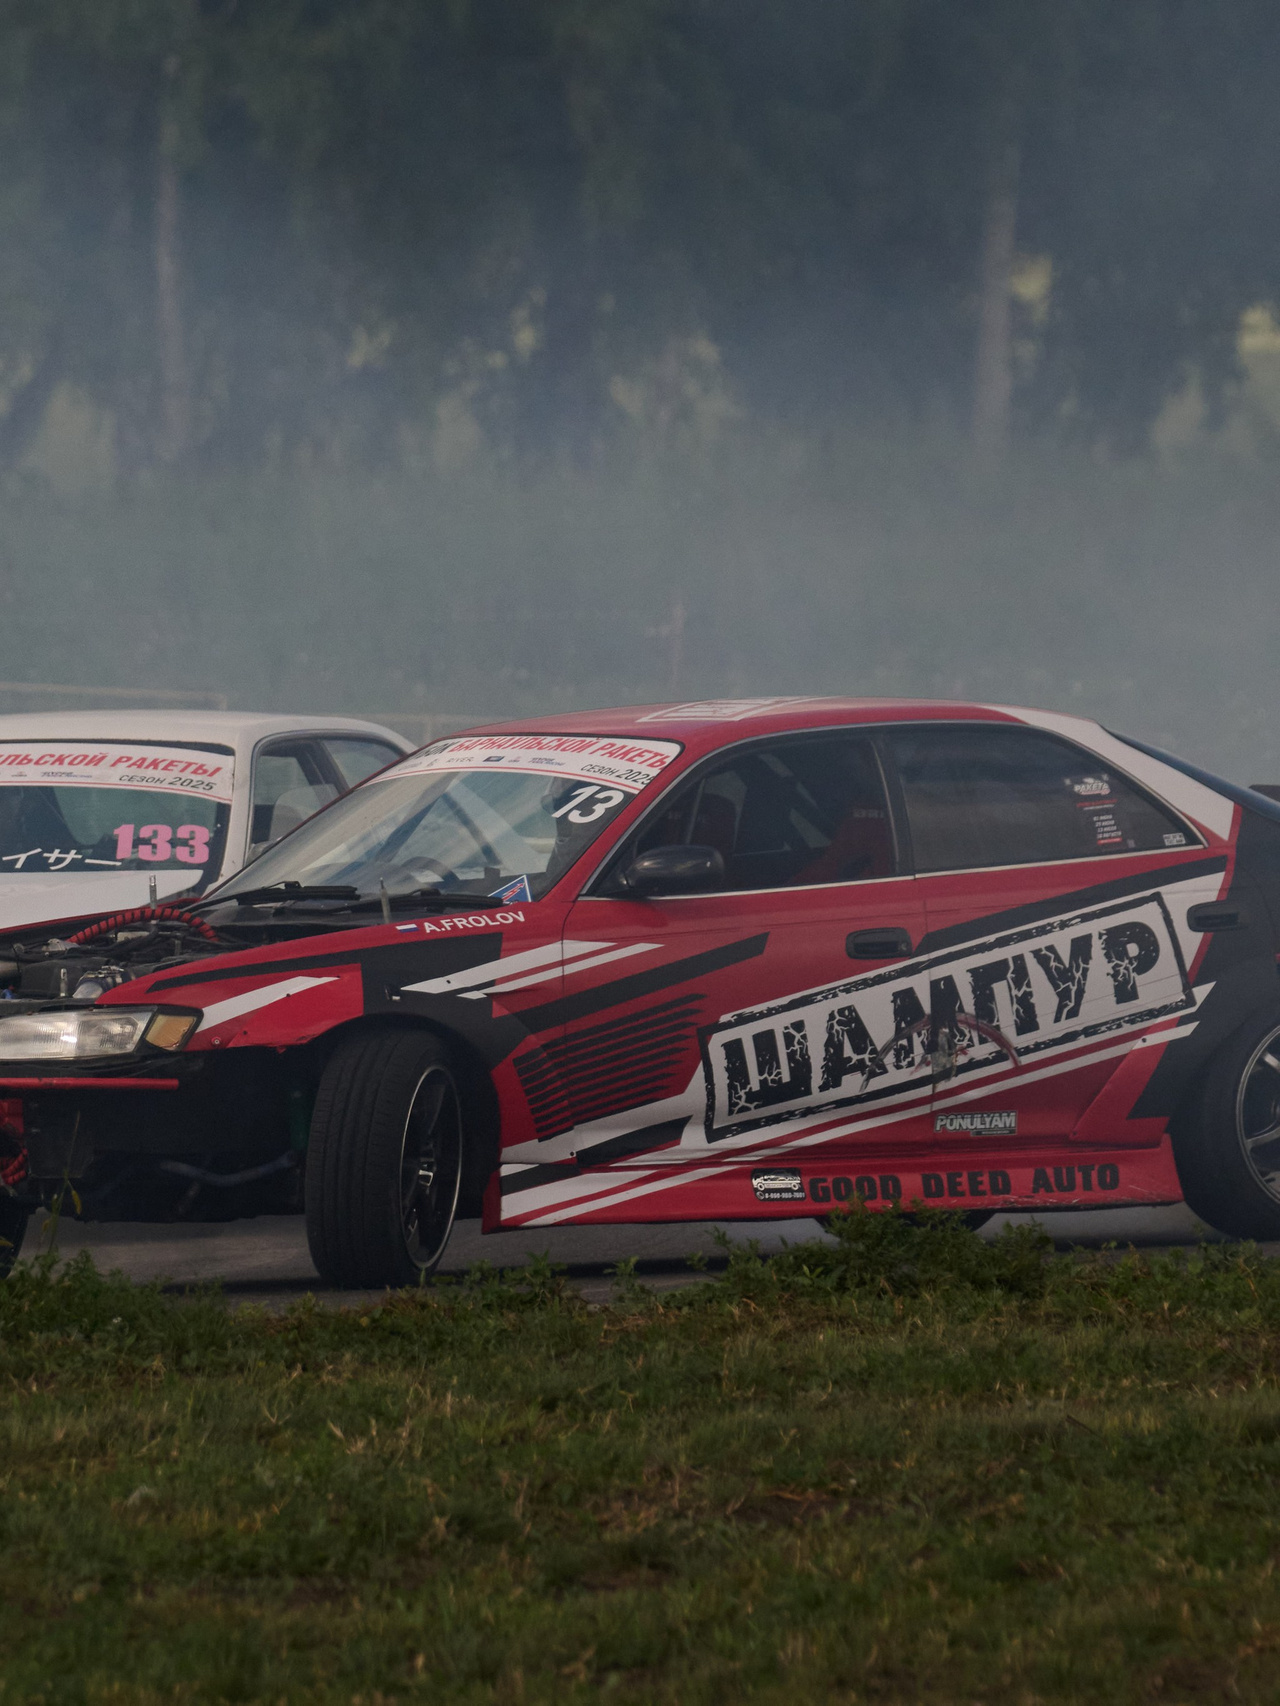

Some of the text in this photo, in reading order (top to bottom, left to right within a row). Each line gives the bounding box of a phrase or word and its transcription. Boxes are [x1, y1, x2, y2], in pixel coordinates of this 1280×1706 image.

[110, 756, 223, 778] РАКЕТЫ
[580, 763, 620, 777] СЕЗОН
[119, 774, 217, 792] СЕЗОН 2025
[551, 785, 625, 824] 13
[113, 824, 210, 864] 133
[423, 910, 526, 934] A.FROLOV
[720, 920, 1161, 1118] ШАМПУР
[934, 1111, 1017, 1131] PONULYAM
[809, 1163, 1120, 1202] GOOD DEED AUTO
